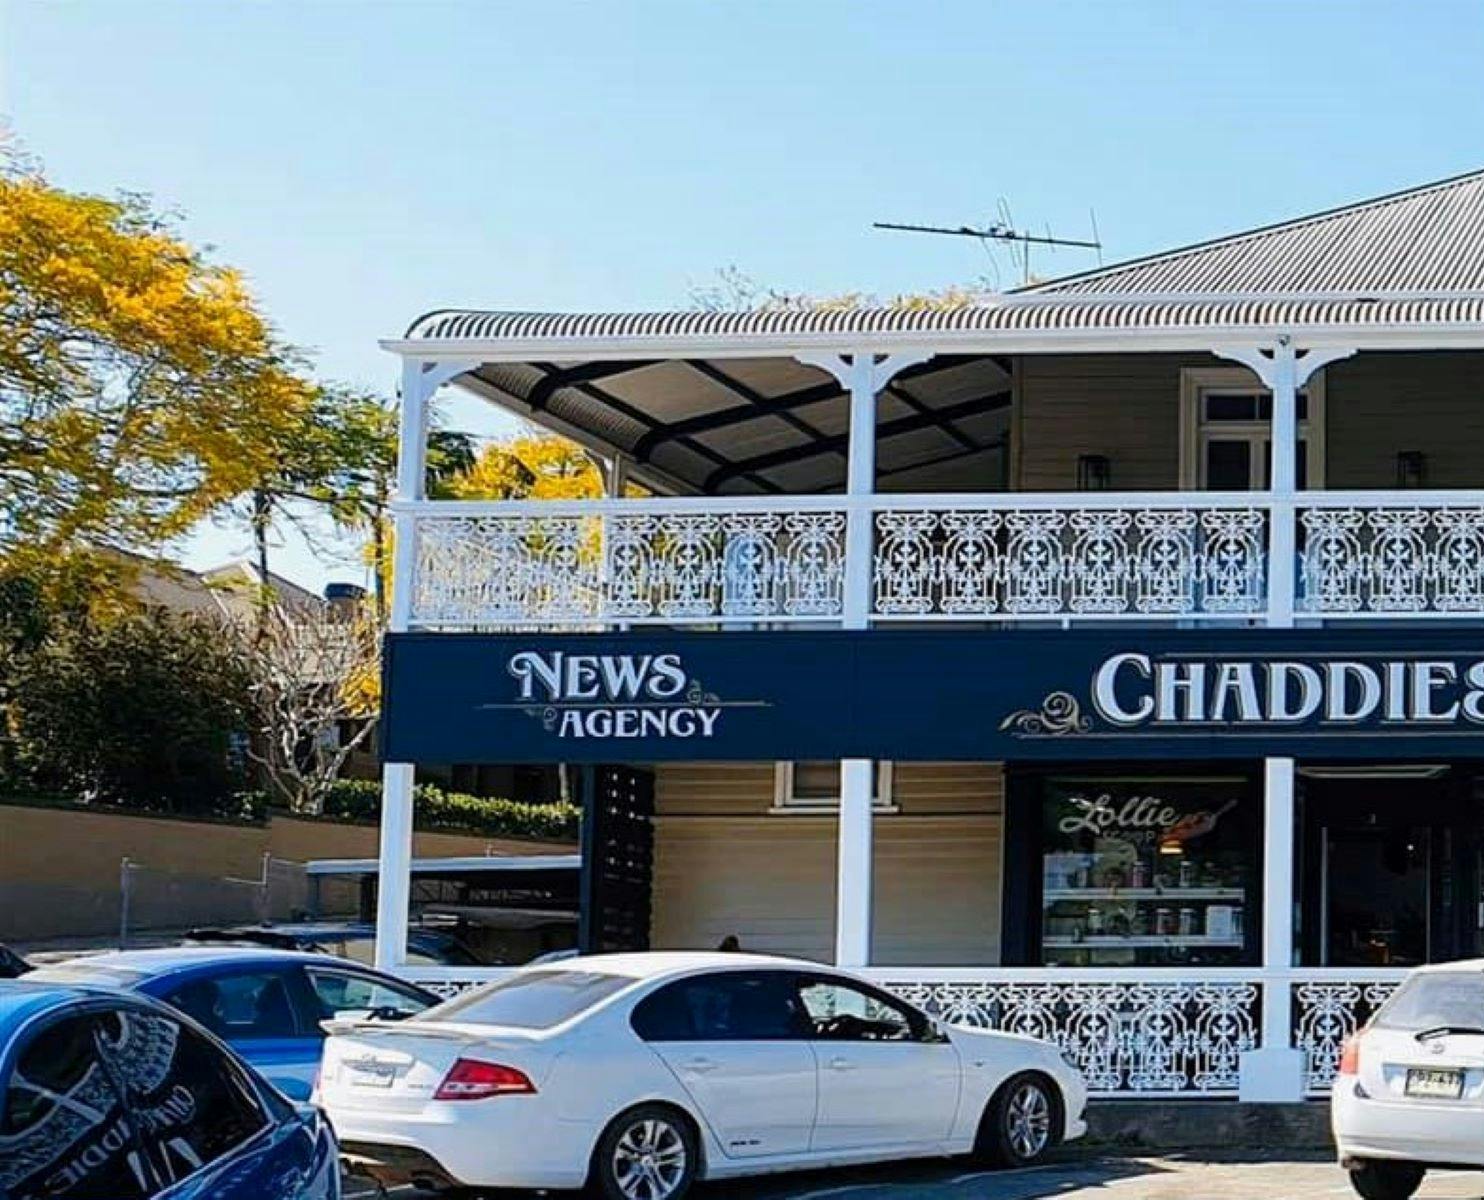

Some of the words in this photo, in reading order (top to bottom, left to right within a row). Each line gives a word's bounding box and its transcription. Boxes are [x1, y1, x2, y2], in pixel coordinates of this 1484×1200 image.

[511, 651, 687, 700] NEWS
[558, 707, 721, 737] AGENCY
[1059, 794, 1179, 834] Lollie
